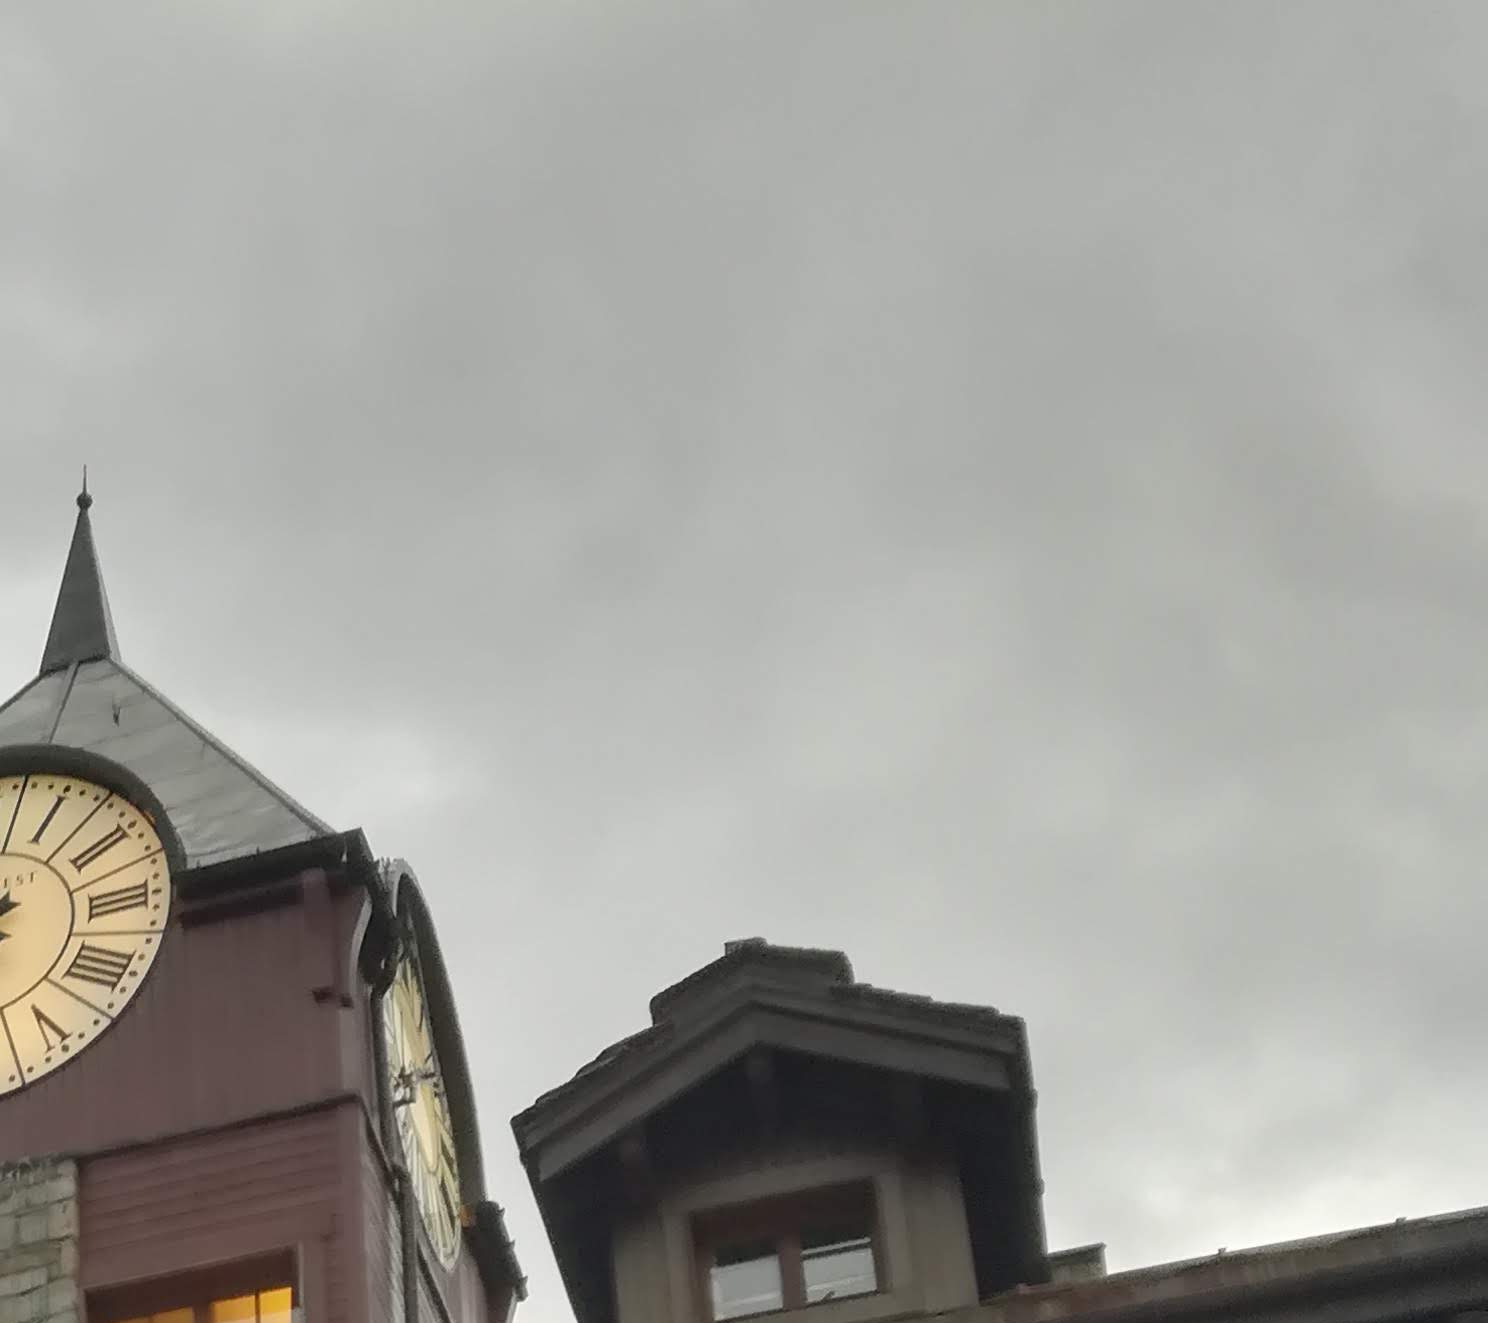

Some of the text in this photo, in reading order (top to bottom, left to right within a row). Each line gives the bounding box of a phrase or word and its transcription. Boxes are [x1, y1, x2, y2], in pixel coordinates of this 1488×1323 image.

[27, 795, 66, 845] I
[69, 823, 131, 874] II
[88, 878, 148, 923] III
[61, 940, 137, 994] IIII
[31, 1004, 72, 1053] V
